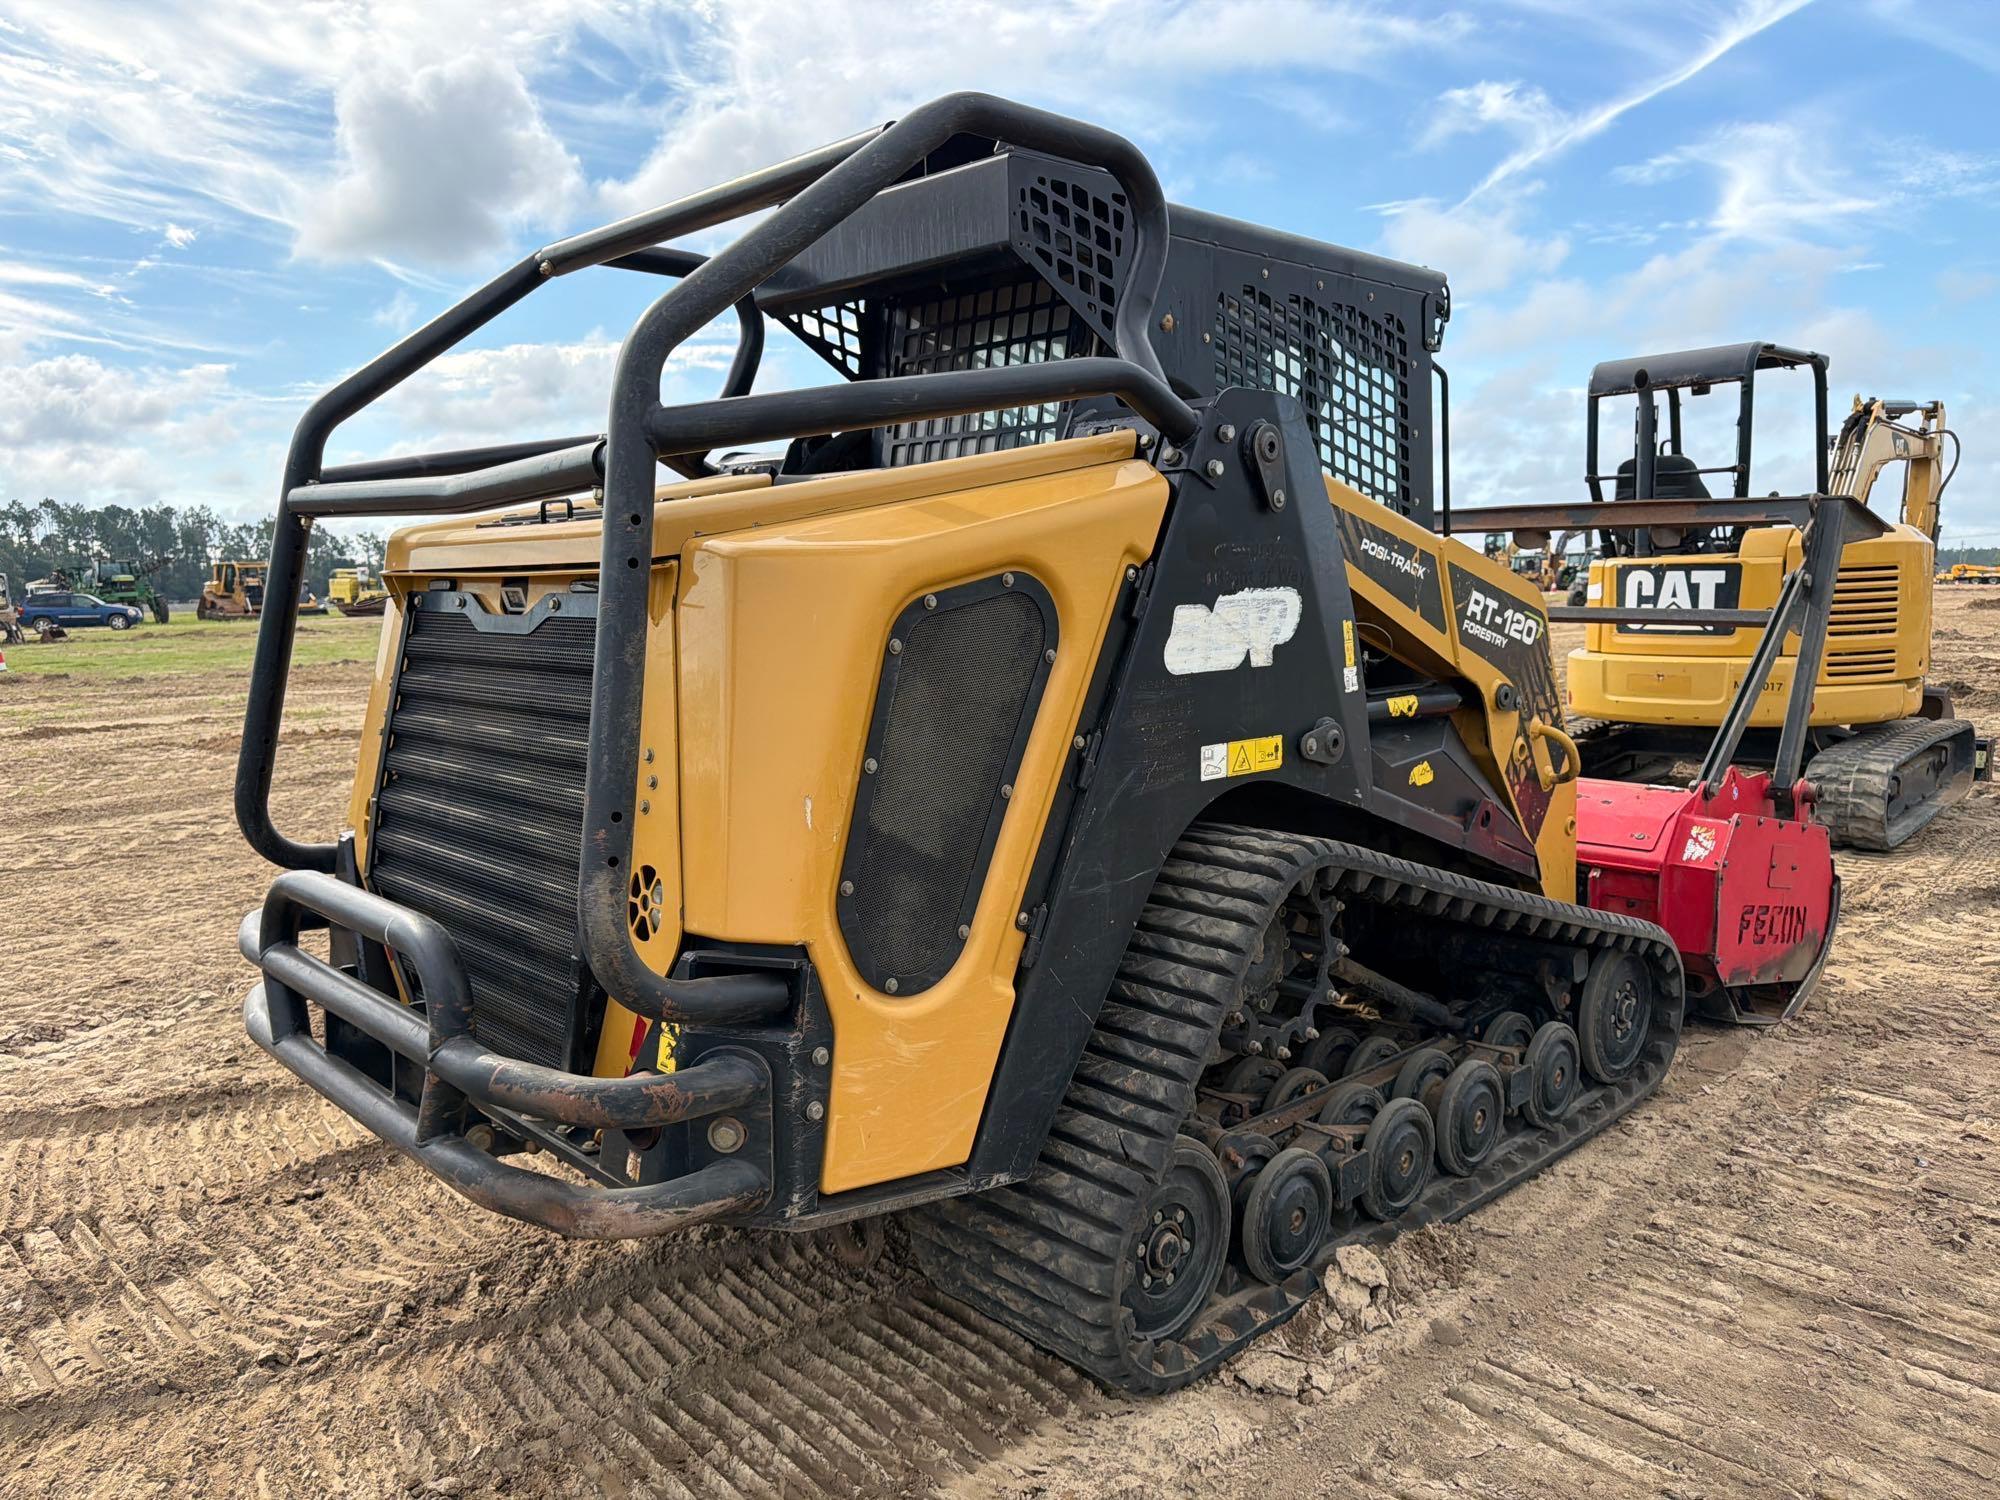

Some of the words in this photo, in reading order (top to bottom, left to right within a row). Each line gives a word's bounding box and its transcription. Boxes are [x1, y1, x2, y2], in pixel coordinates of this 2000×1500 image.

[1360, 538, 1426, 579] POSI-TRACK
[1466, 590, 1537, 645] RT-120
[1625, 569, 1726, 630] CAT
[1462, 619, 1508, 648] FORESTRY
[1738, 905, 1807, 945] FECON
